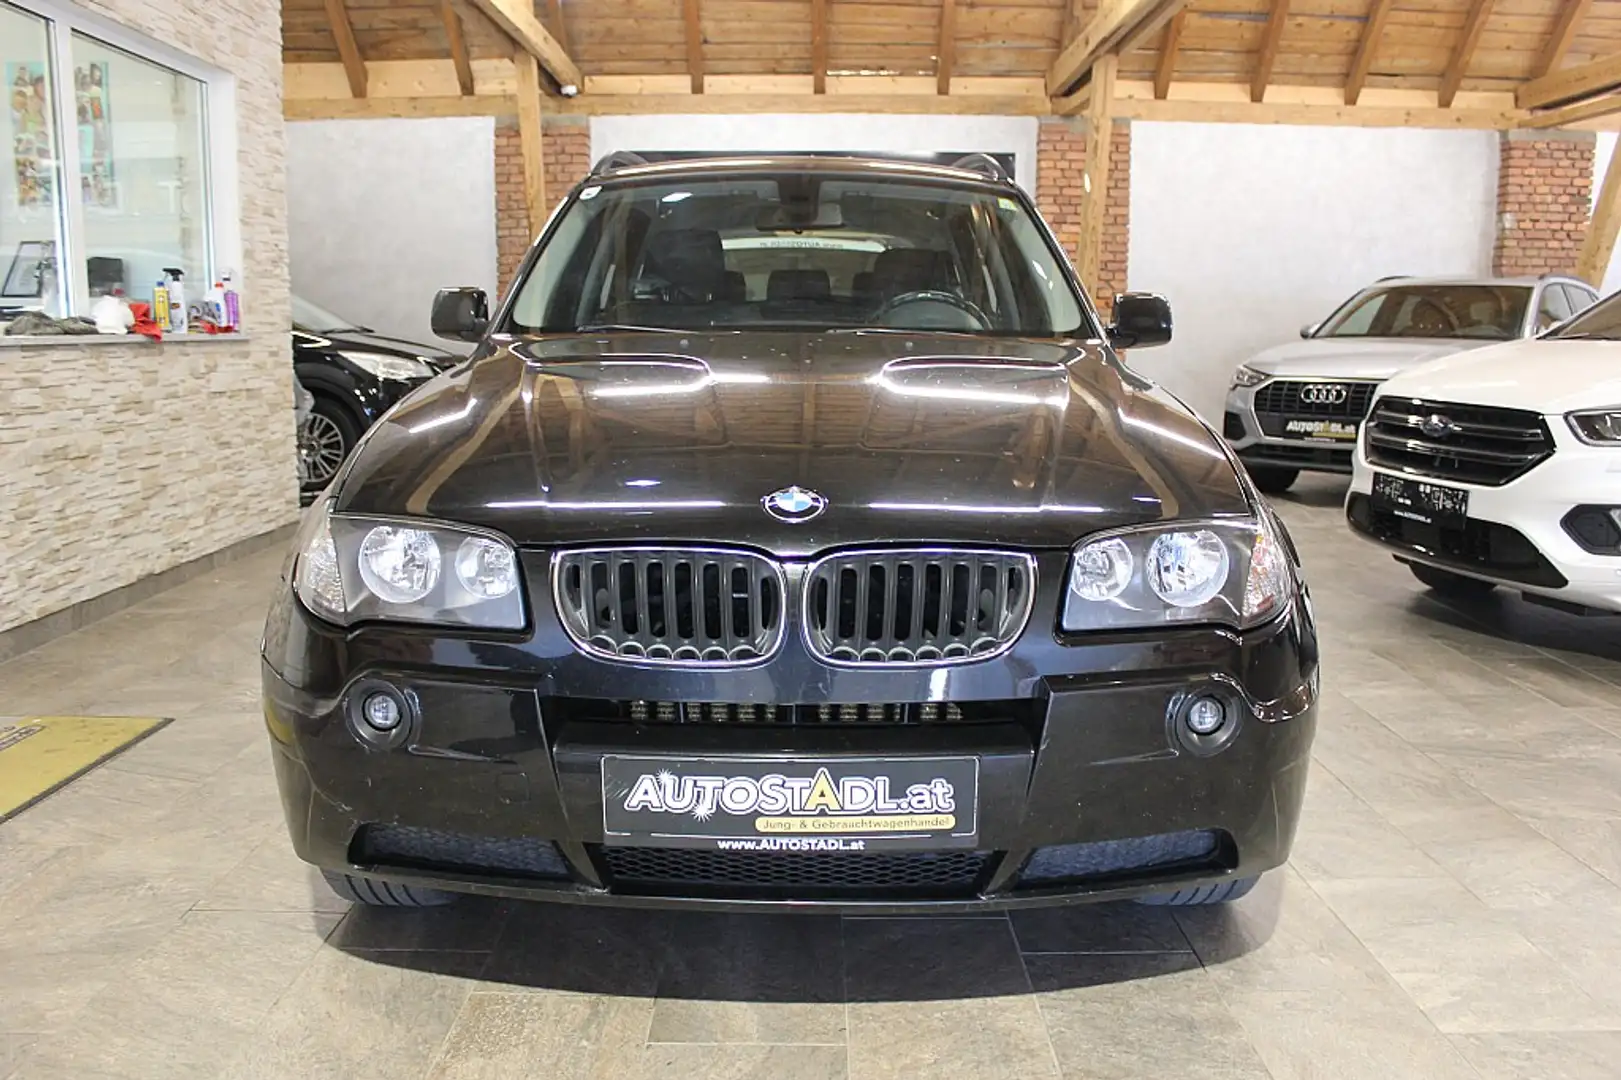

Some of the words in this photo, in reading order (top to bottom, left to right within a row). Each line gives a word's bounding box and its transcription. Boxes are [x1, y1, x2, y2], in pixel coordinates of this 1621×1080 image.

[624, 767, 956, 815] AUTOSTADL.at
[799, 819, 809, 830] &
[811, 817, 950, 830] Gebrauchtwagenhandel
[717, 838, 866, 851] www.AUTOSTADL.at
